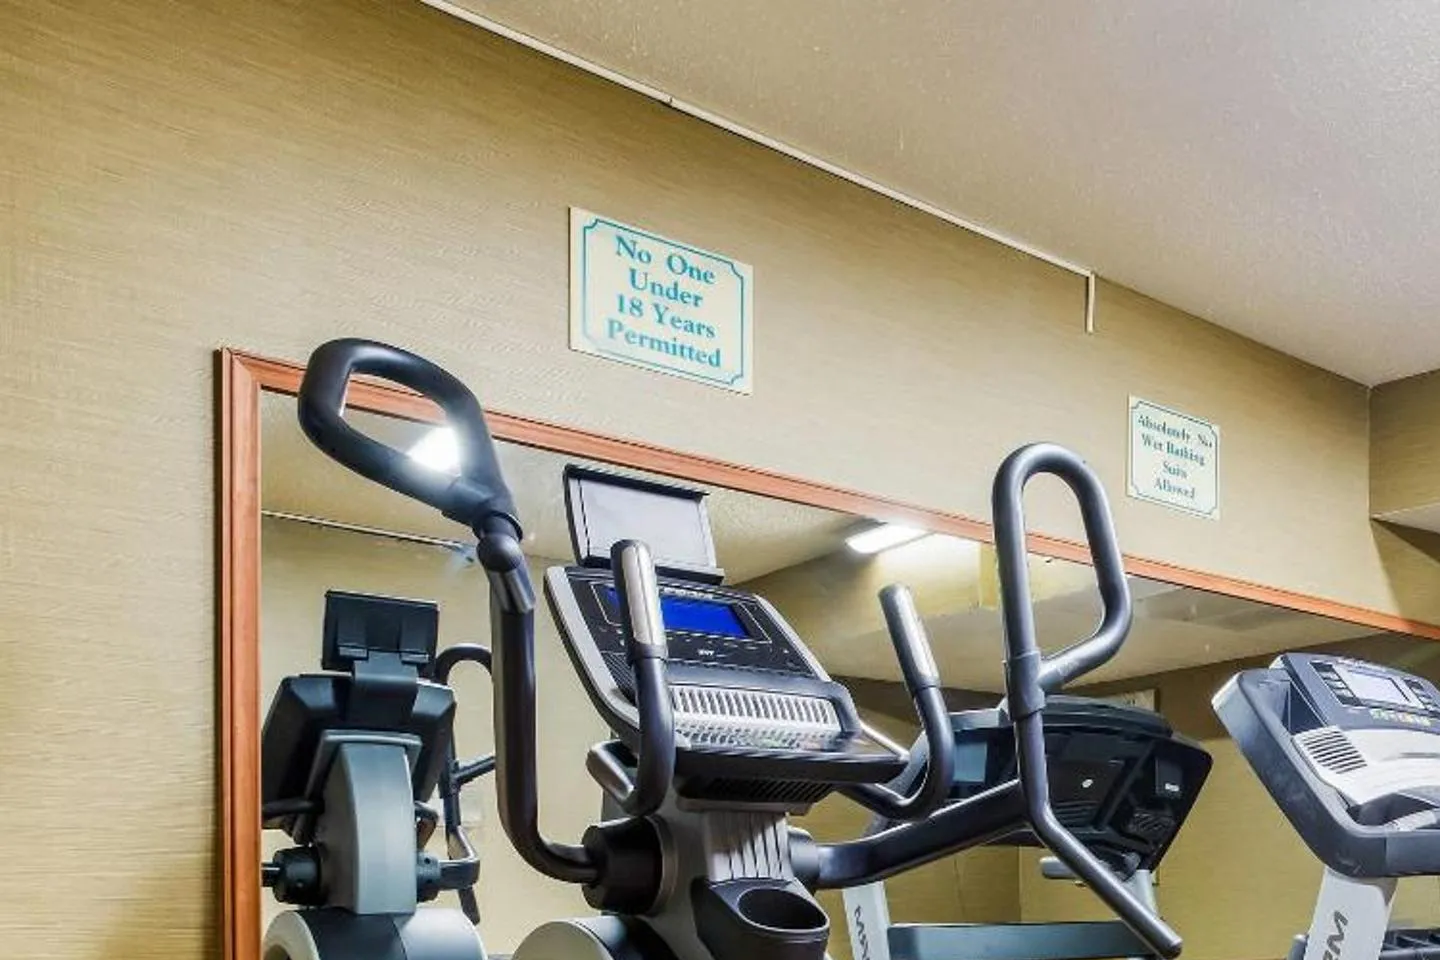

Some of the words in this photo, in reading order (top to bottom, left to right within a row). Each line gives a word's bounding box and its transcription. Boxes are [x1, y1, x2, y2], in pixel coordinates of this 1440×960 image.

[615, 235, 651, 263] No
[666, 254, 716, 284] One
[629, 268, 704, 308] Under
[616, 293, 644, 318] 18
[652, 303, 716, 338] Years
[607, 318, 722, 367] Permitted
